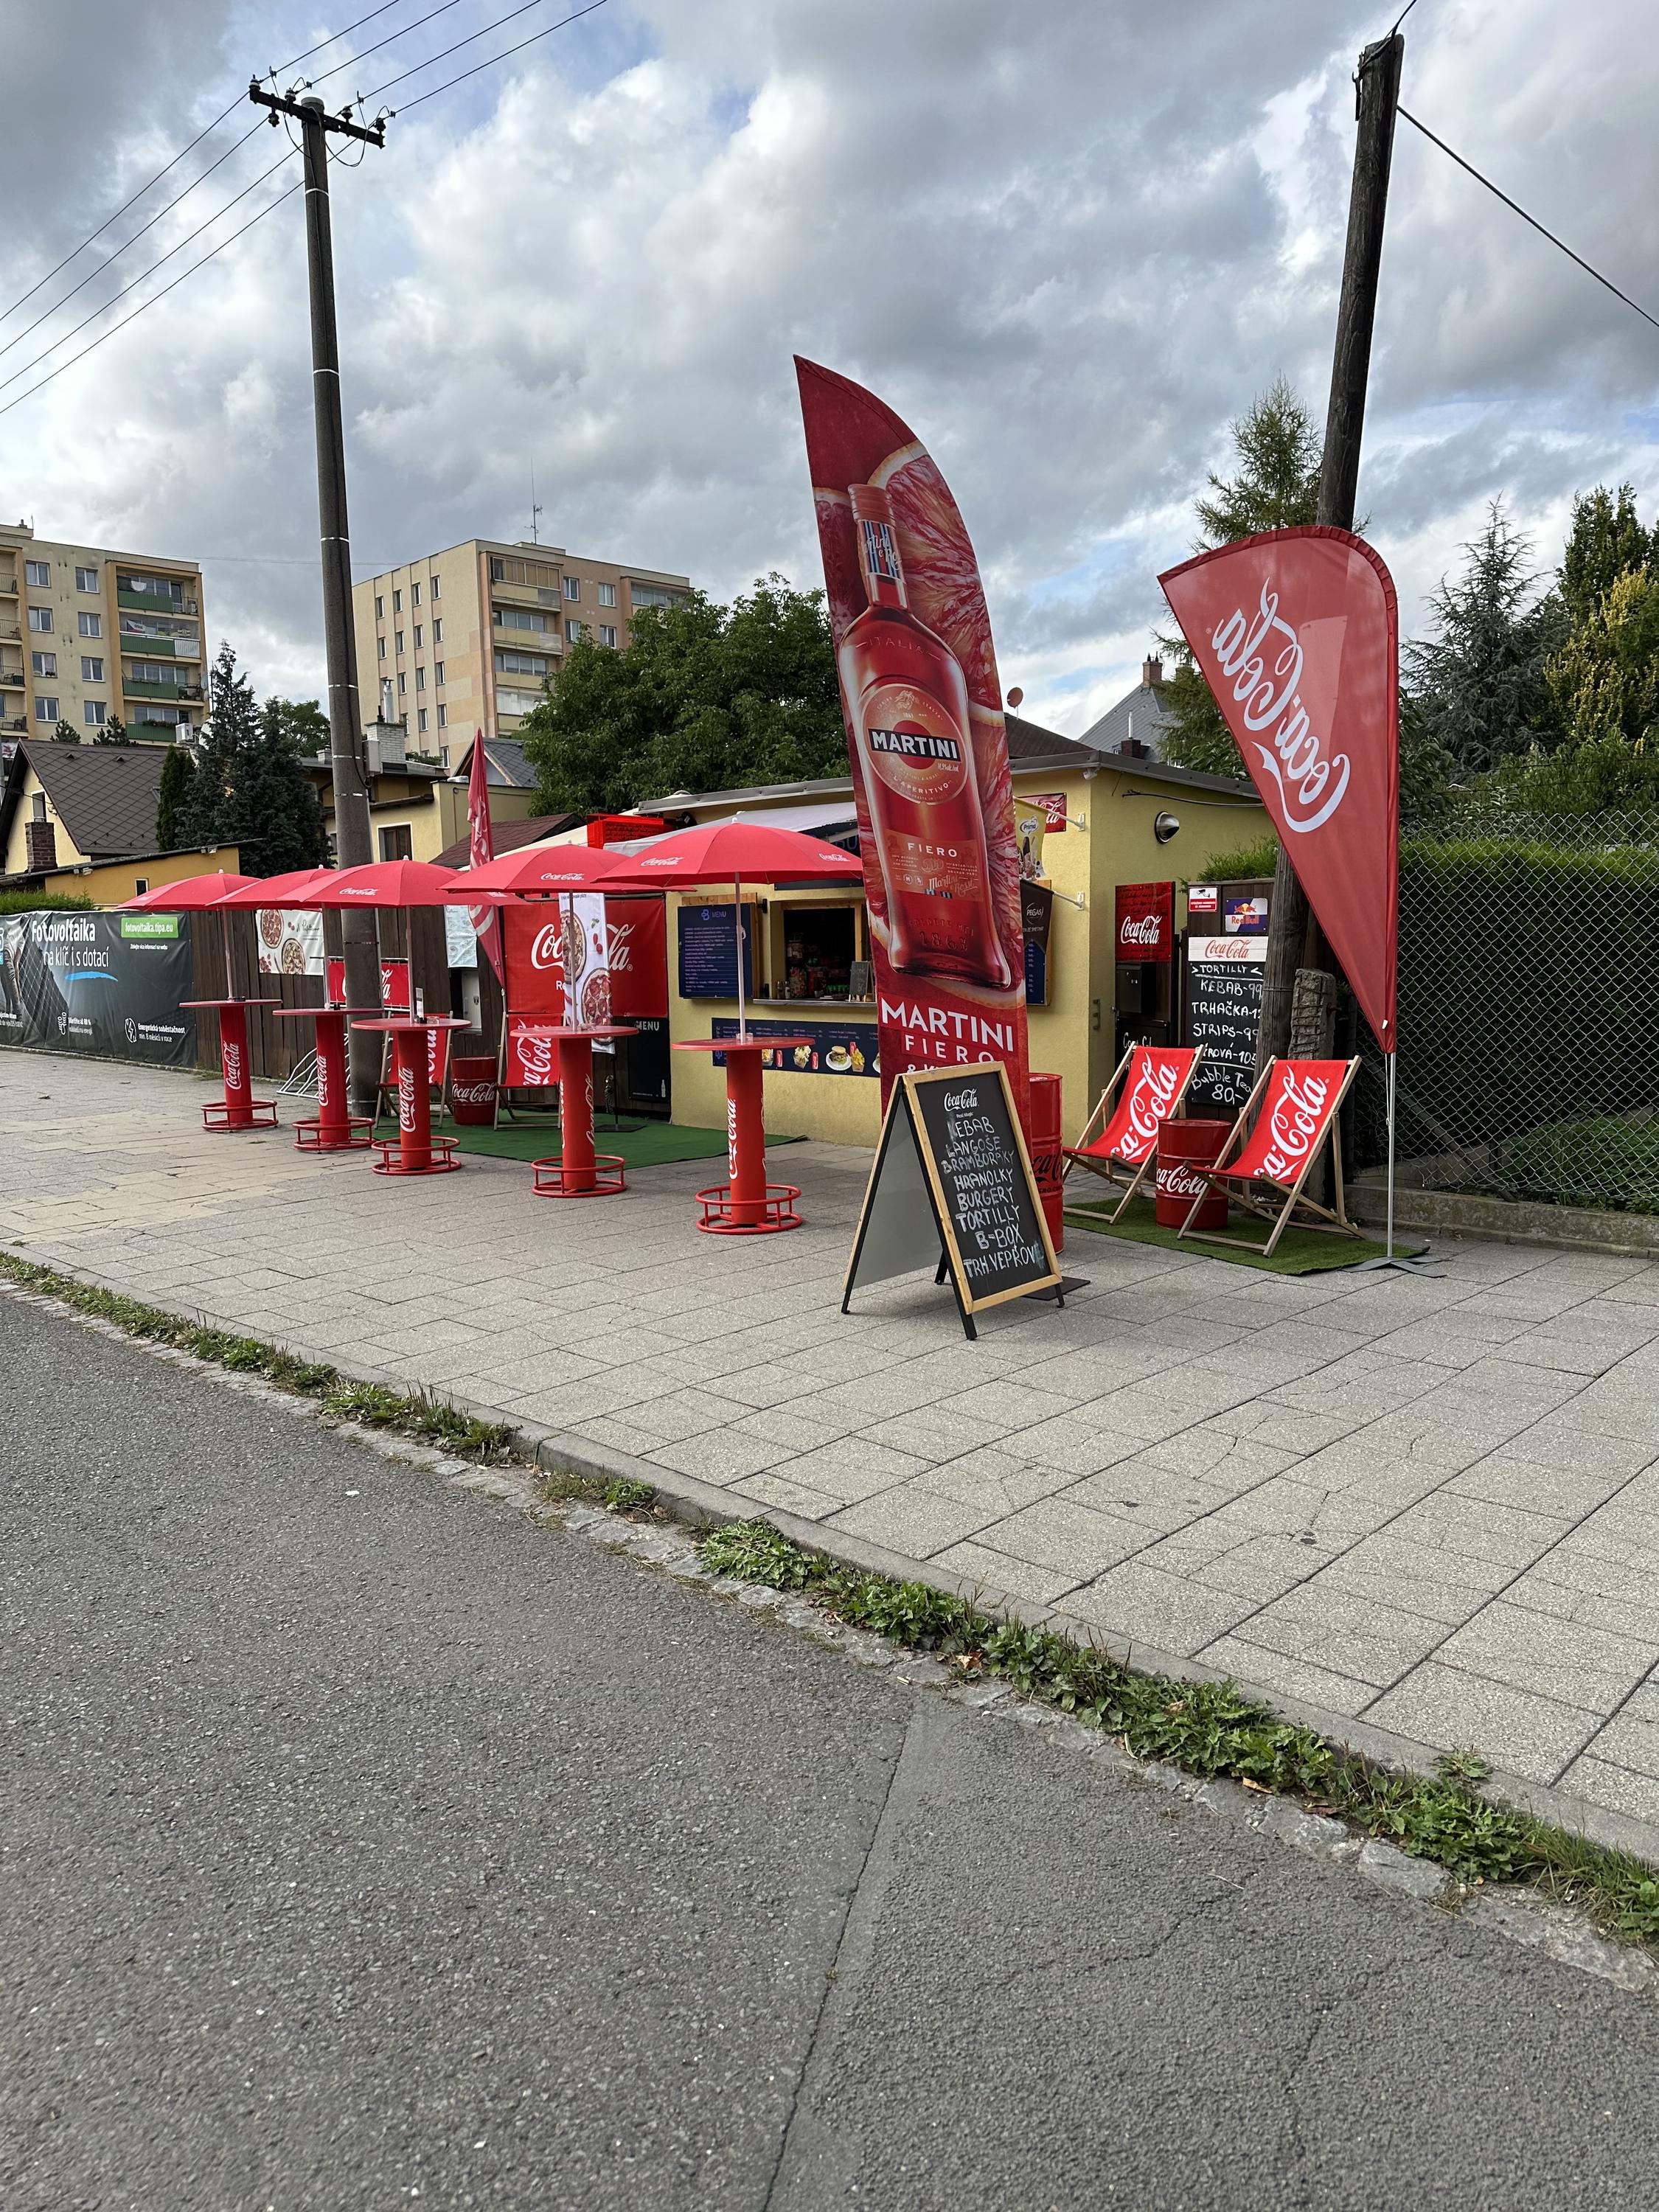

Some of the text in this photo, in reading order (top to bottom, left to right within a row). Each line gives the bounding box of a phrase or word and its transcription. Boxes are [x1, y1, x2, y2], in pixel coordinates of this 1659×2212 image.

[872, 731, 958, 759] MARTINI
[641, 856, 684, 866] Coca-Cola
[907, 842, 958, 858] FIERO
[540, 872, 585, 881] Coca-Cola
[339, 887, 378, 896] Coca-Cola
[1026, 908, 1042, 917] PEGAS
[125, 922, 173, 935] fotovoltaika.tipa.eu
[1121, 915, 1163, 945] Coca-Cola
[44, 945, 110, 967] na klíč i s dotací
[1205, 939, 1251, 959] Coca-Cola
[1200, 964, 1249, 975] TORTILLY
[635, 1020, 659, 1031] MENU
[881, 998, 1014, 1051] MARTINI
[905, 1034, 995, 1063] FIERO
[223, 1040, 242, 1090] Coca-Cola
[1191, 1067, 1253, 1093] Bubble Tea
[399, 1067, 416, 1133] Coca-Cola
[452, 1082, 498, 1103] Coca-Cola
[944, 1088, 977, 1111] Coca-Cola
[947, 1116, 995, 1141] KEBAB
[945, 1135, 1001, 1158] LANGOŠE
[953, 1168, 1013, 1192] HRANOLKY
[956, 1186, 1013, 1211] BURGERY
[955, 1204, 1020, 1233] TORTILLY
